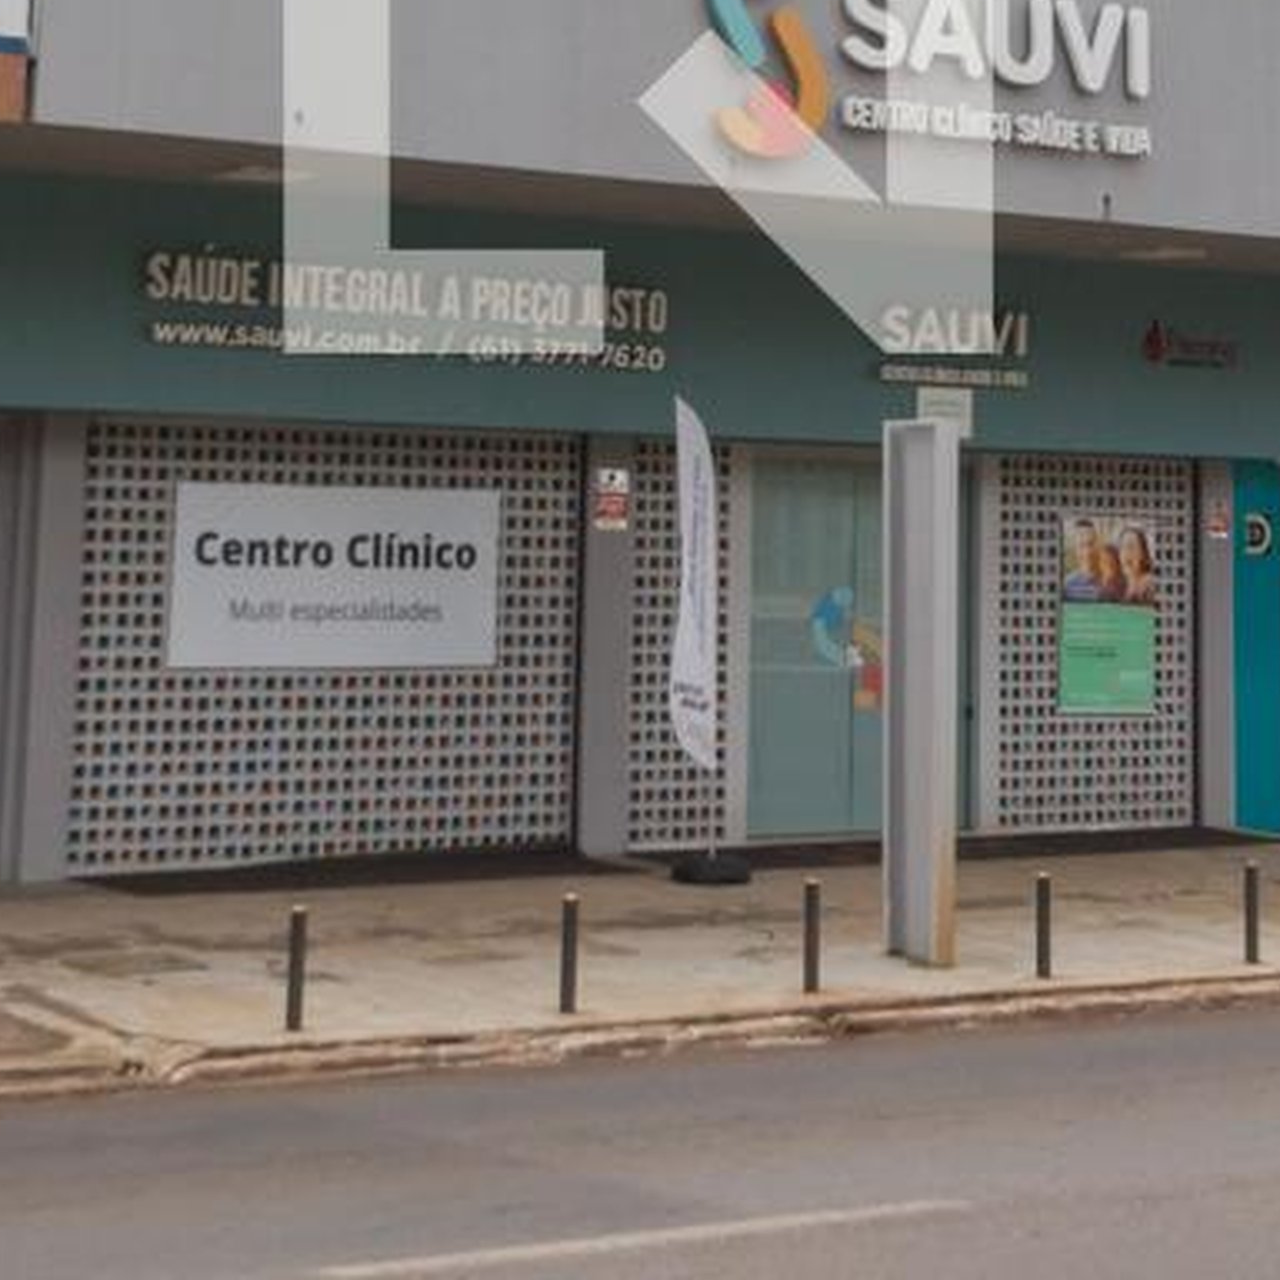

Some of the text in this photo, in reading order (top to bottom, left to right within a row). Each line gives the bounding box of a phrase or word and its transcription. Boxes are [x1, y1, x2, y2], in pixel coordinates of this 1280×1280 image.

[147, 244, 262, 308] SAÚDE
[268, 260, 428, 318] INTEGRAL
[438, 272, 460, 318] A
[470, 277, 572, 331] PREÇO
[882, 302, 1028, 356] SAUVI
[194, 531, 478, 571] Centro Clínico
